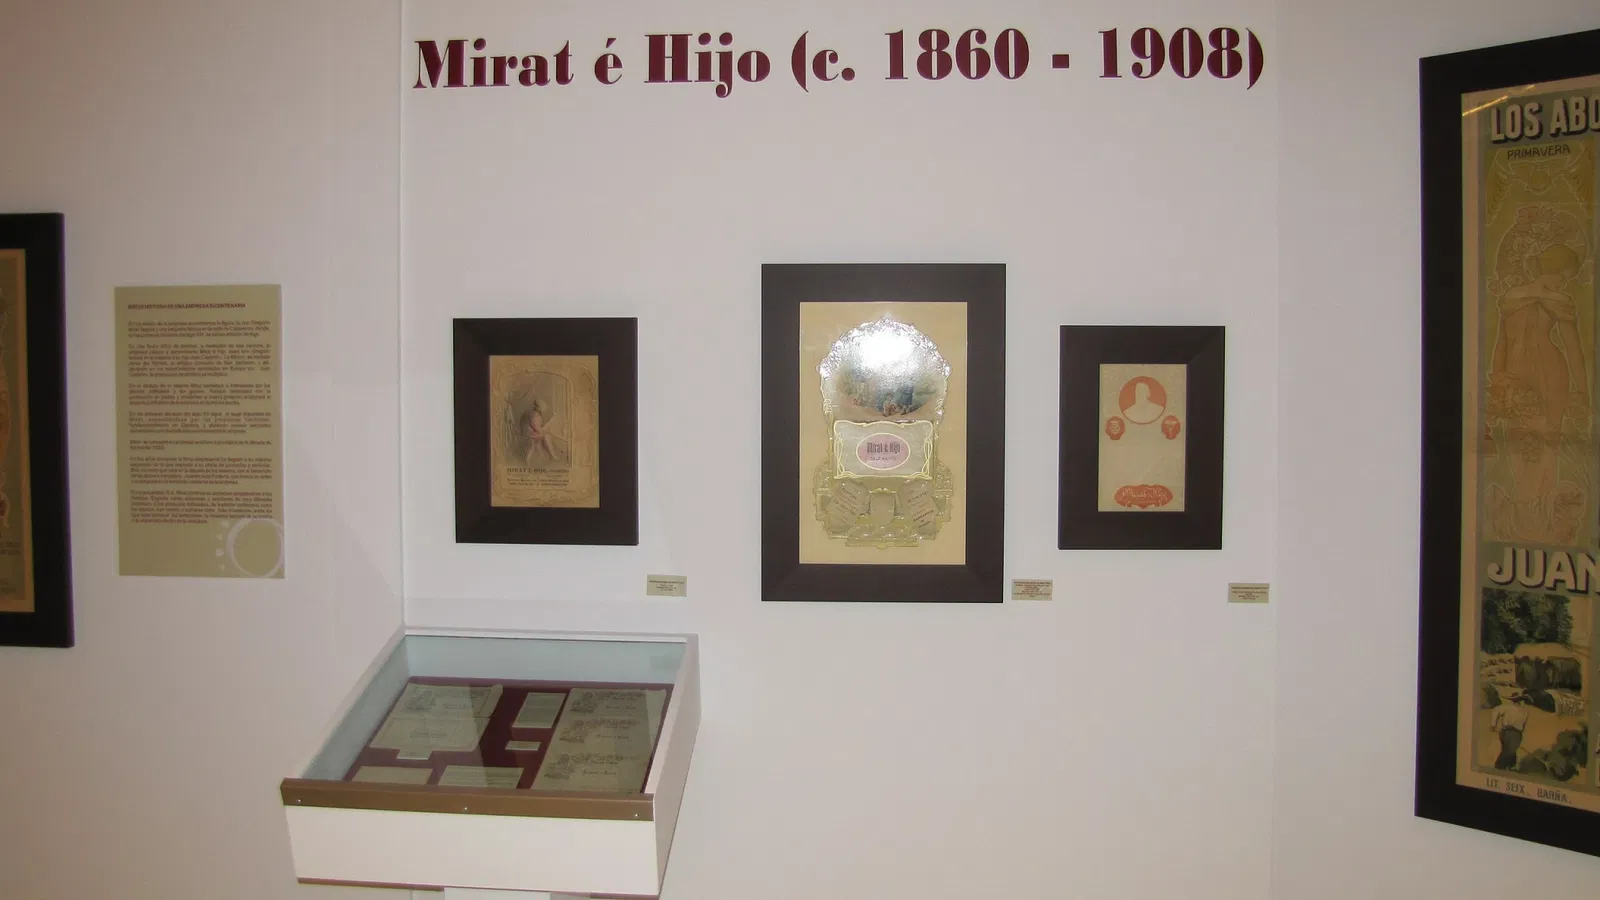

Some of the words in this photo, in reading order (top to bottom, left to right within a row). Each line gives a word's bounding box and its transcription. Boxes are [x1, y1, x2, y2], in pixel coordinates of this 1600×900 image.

[413, 38, 574, 88] Mirat
[594, 37, 623, 85] é
[644, 32, 771, 98] Hijo
[791, 31, 855, 93] (c.
[885, 28, 1030, 80] 1860
[1098, 27, 1264, 90] 1908)
[1491, 102, 1543, 143] LOS
[1507, 143, 1570, 160] PRIMAVERA
